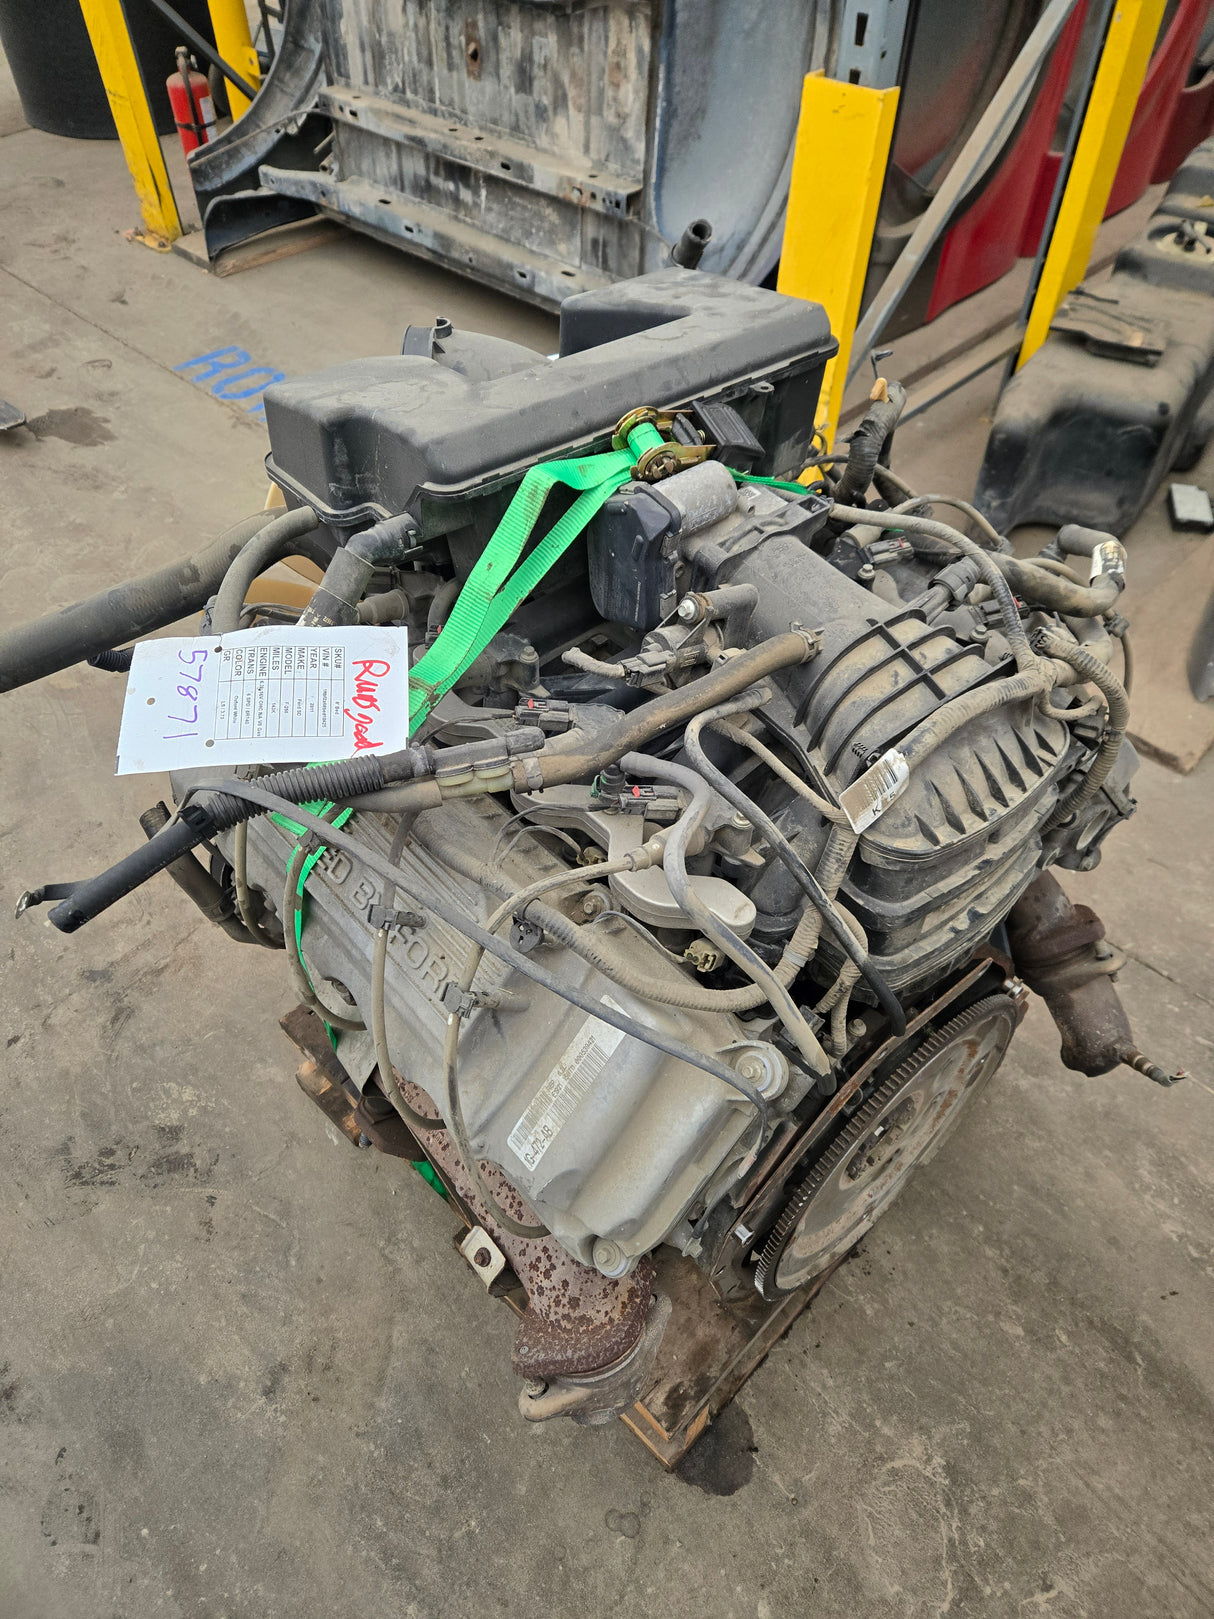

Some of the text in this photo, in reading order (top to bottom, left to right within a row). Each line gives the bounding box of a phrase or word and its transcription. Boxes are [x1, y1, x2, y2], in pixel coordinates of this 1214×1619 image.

[224, 651, 231, 661] GR
[235, 649, 243, 676] COLOR
[247, 648, 255, 674] TRANS
[259, 647, 267, 676] ENGINE
[272, 647, 280, 670] MILES
[284, 647, 293, 674] MODEL
[297, 647, 305, 669] MAKE
[162, 649, 208, 740] 57871
